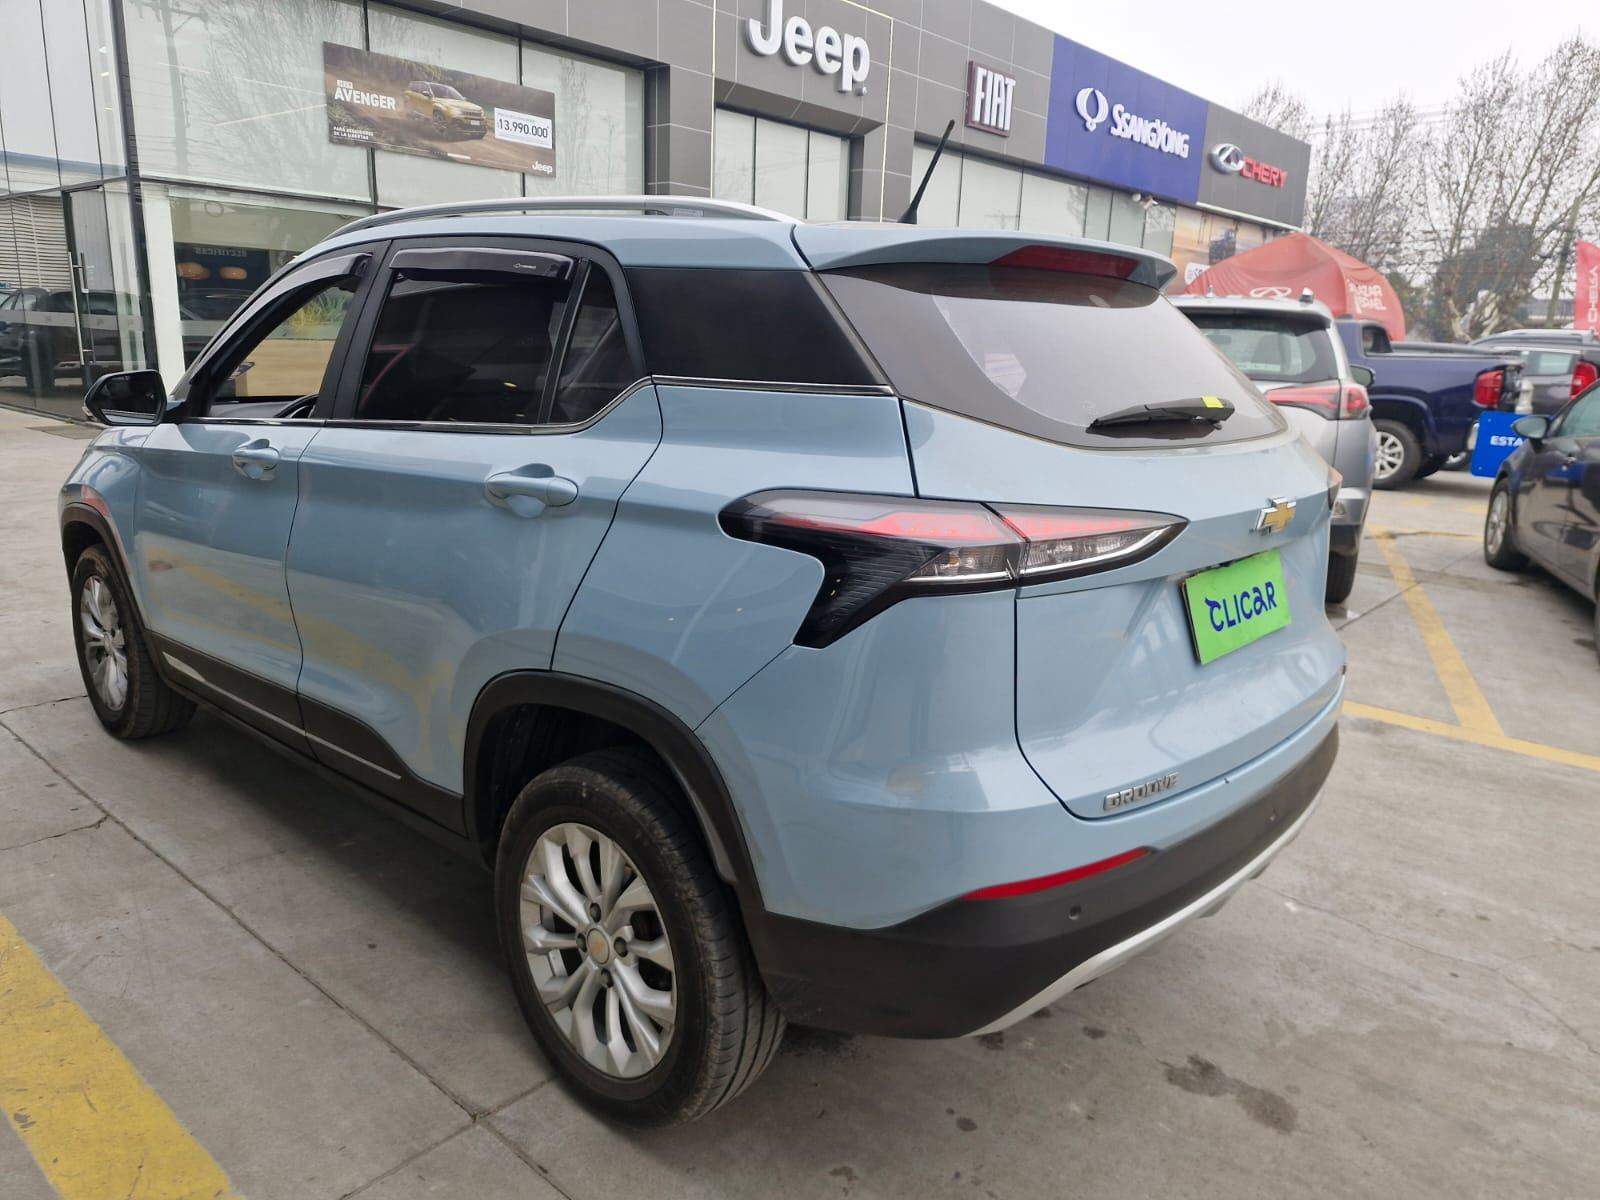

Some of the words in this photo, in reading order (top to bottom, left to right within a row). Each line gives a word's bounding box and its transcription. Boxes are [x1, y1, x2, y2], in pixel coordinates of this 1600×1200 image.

[748, 0, 871, 92] Jeep
[334, 87, 397, 112] AVENGER
[971, 66, 1017, 132] FIAT
[531, 160, 553, 174] Jeep
[1240, 156, 1288, 188] CHERY
